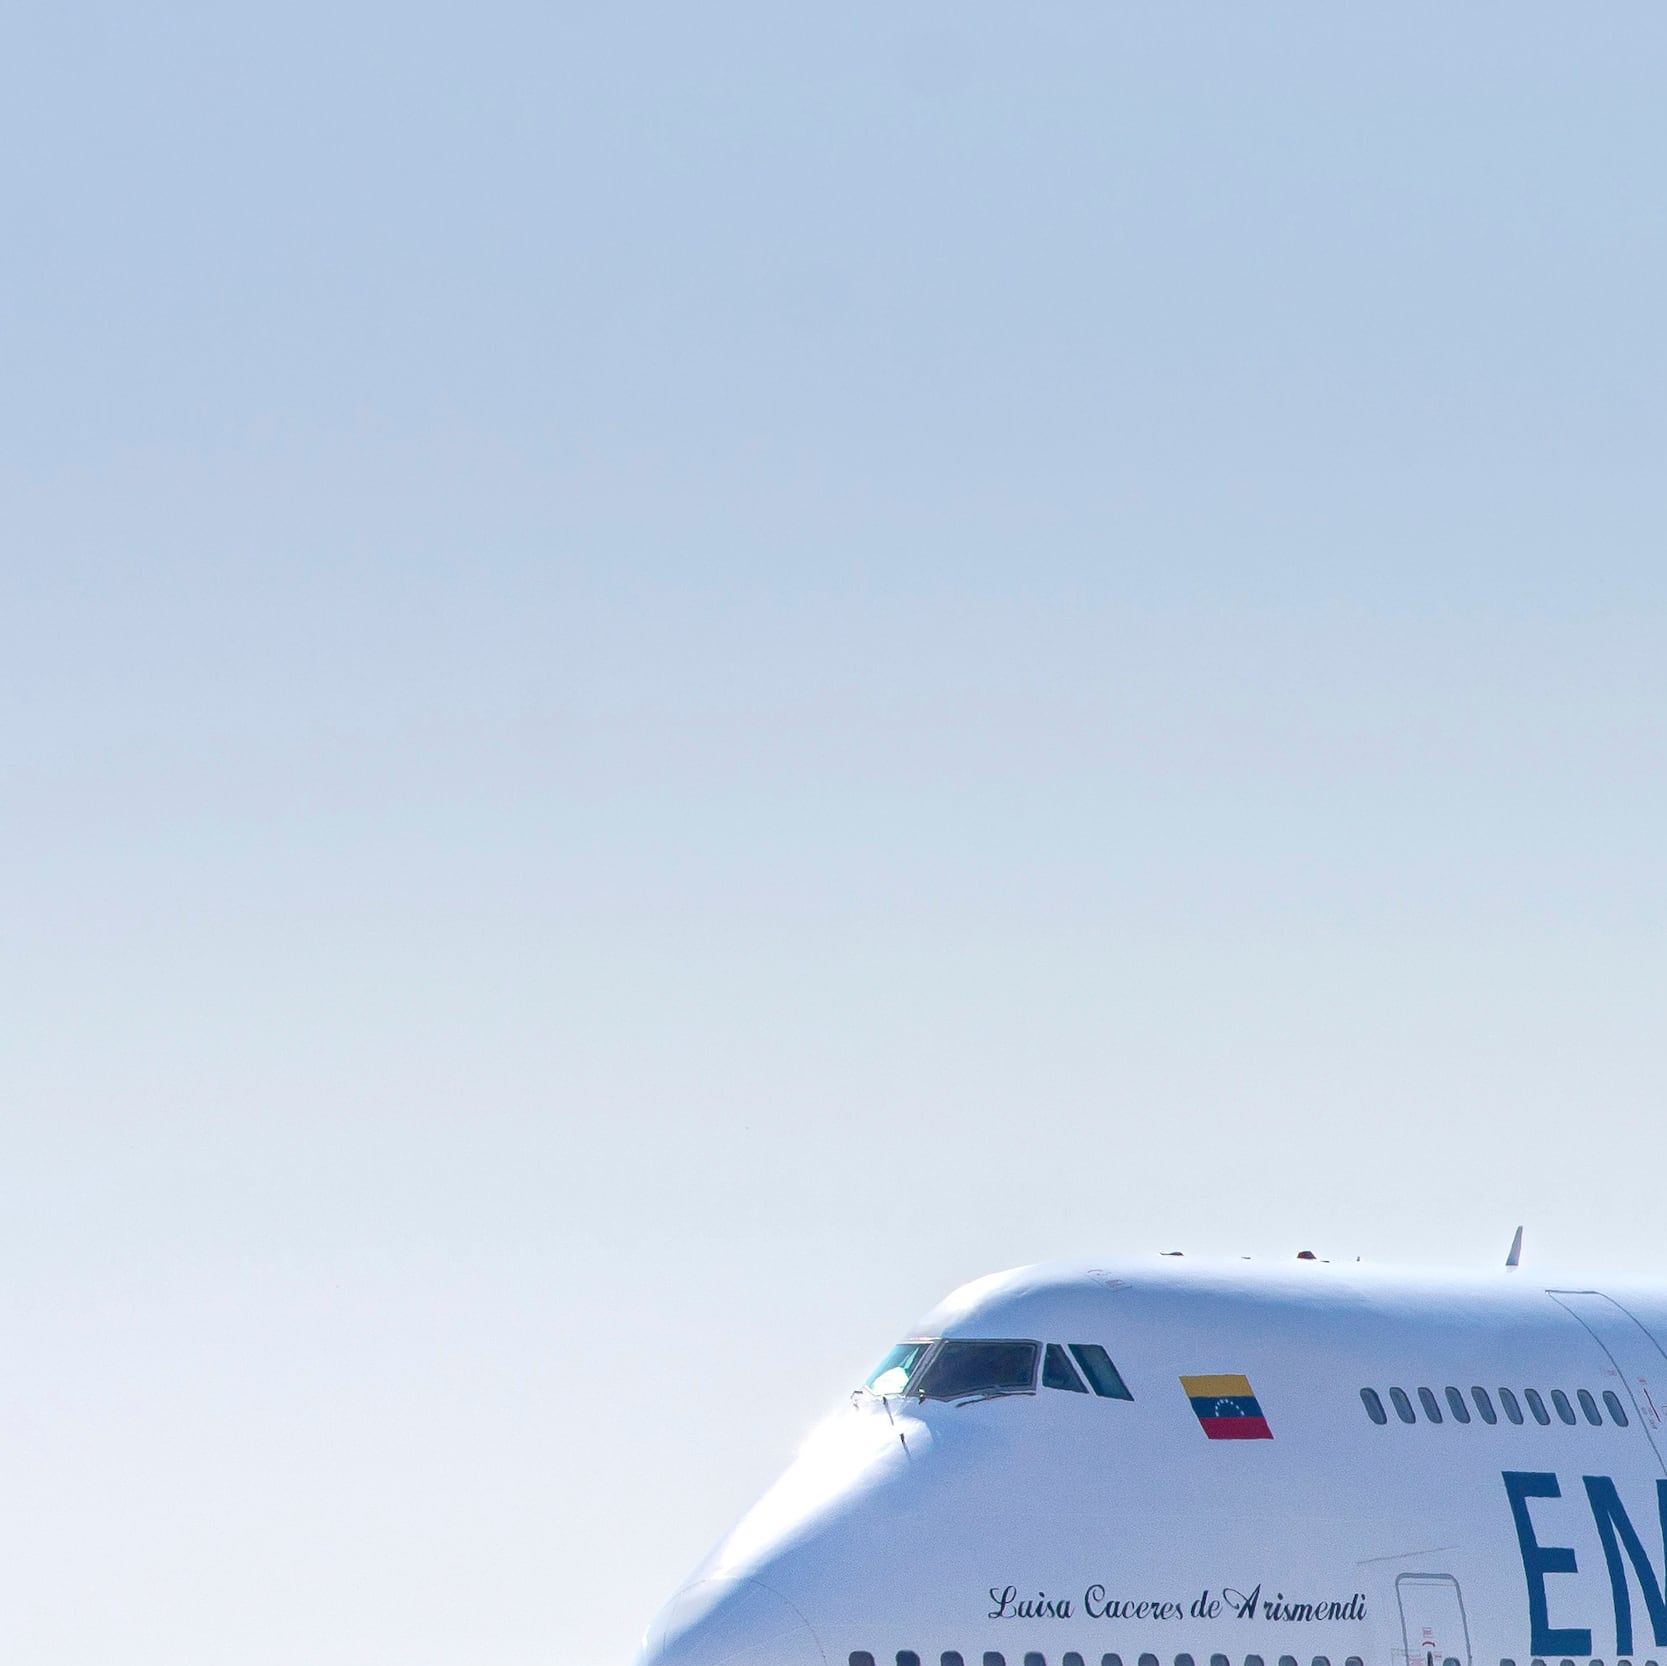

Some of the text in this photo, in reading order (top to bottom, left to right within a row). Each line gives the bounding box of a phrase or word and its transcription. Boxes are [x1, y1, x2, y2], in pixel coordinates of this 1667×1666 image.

[987, 1584, 1074, 1620] Luisa
[1083, 1583, 1184, 1621] Caceres
[1190, 1589, 1223, 1620] de
